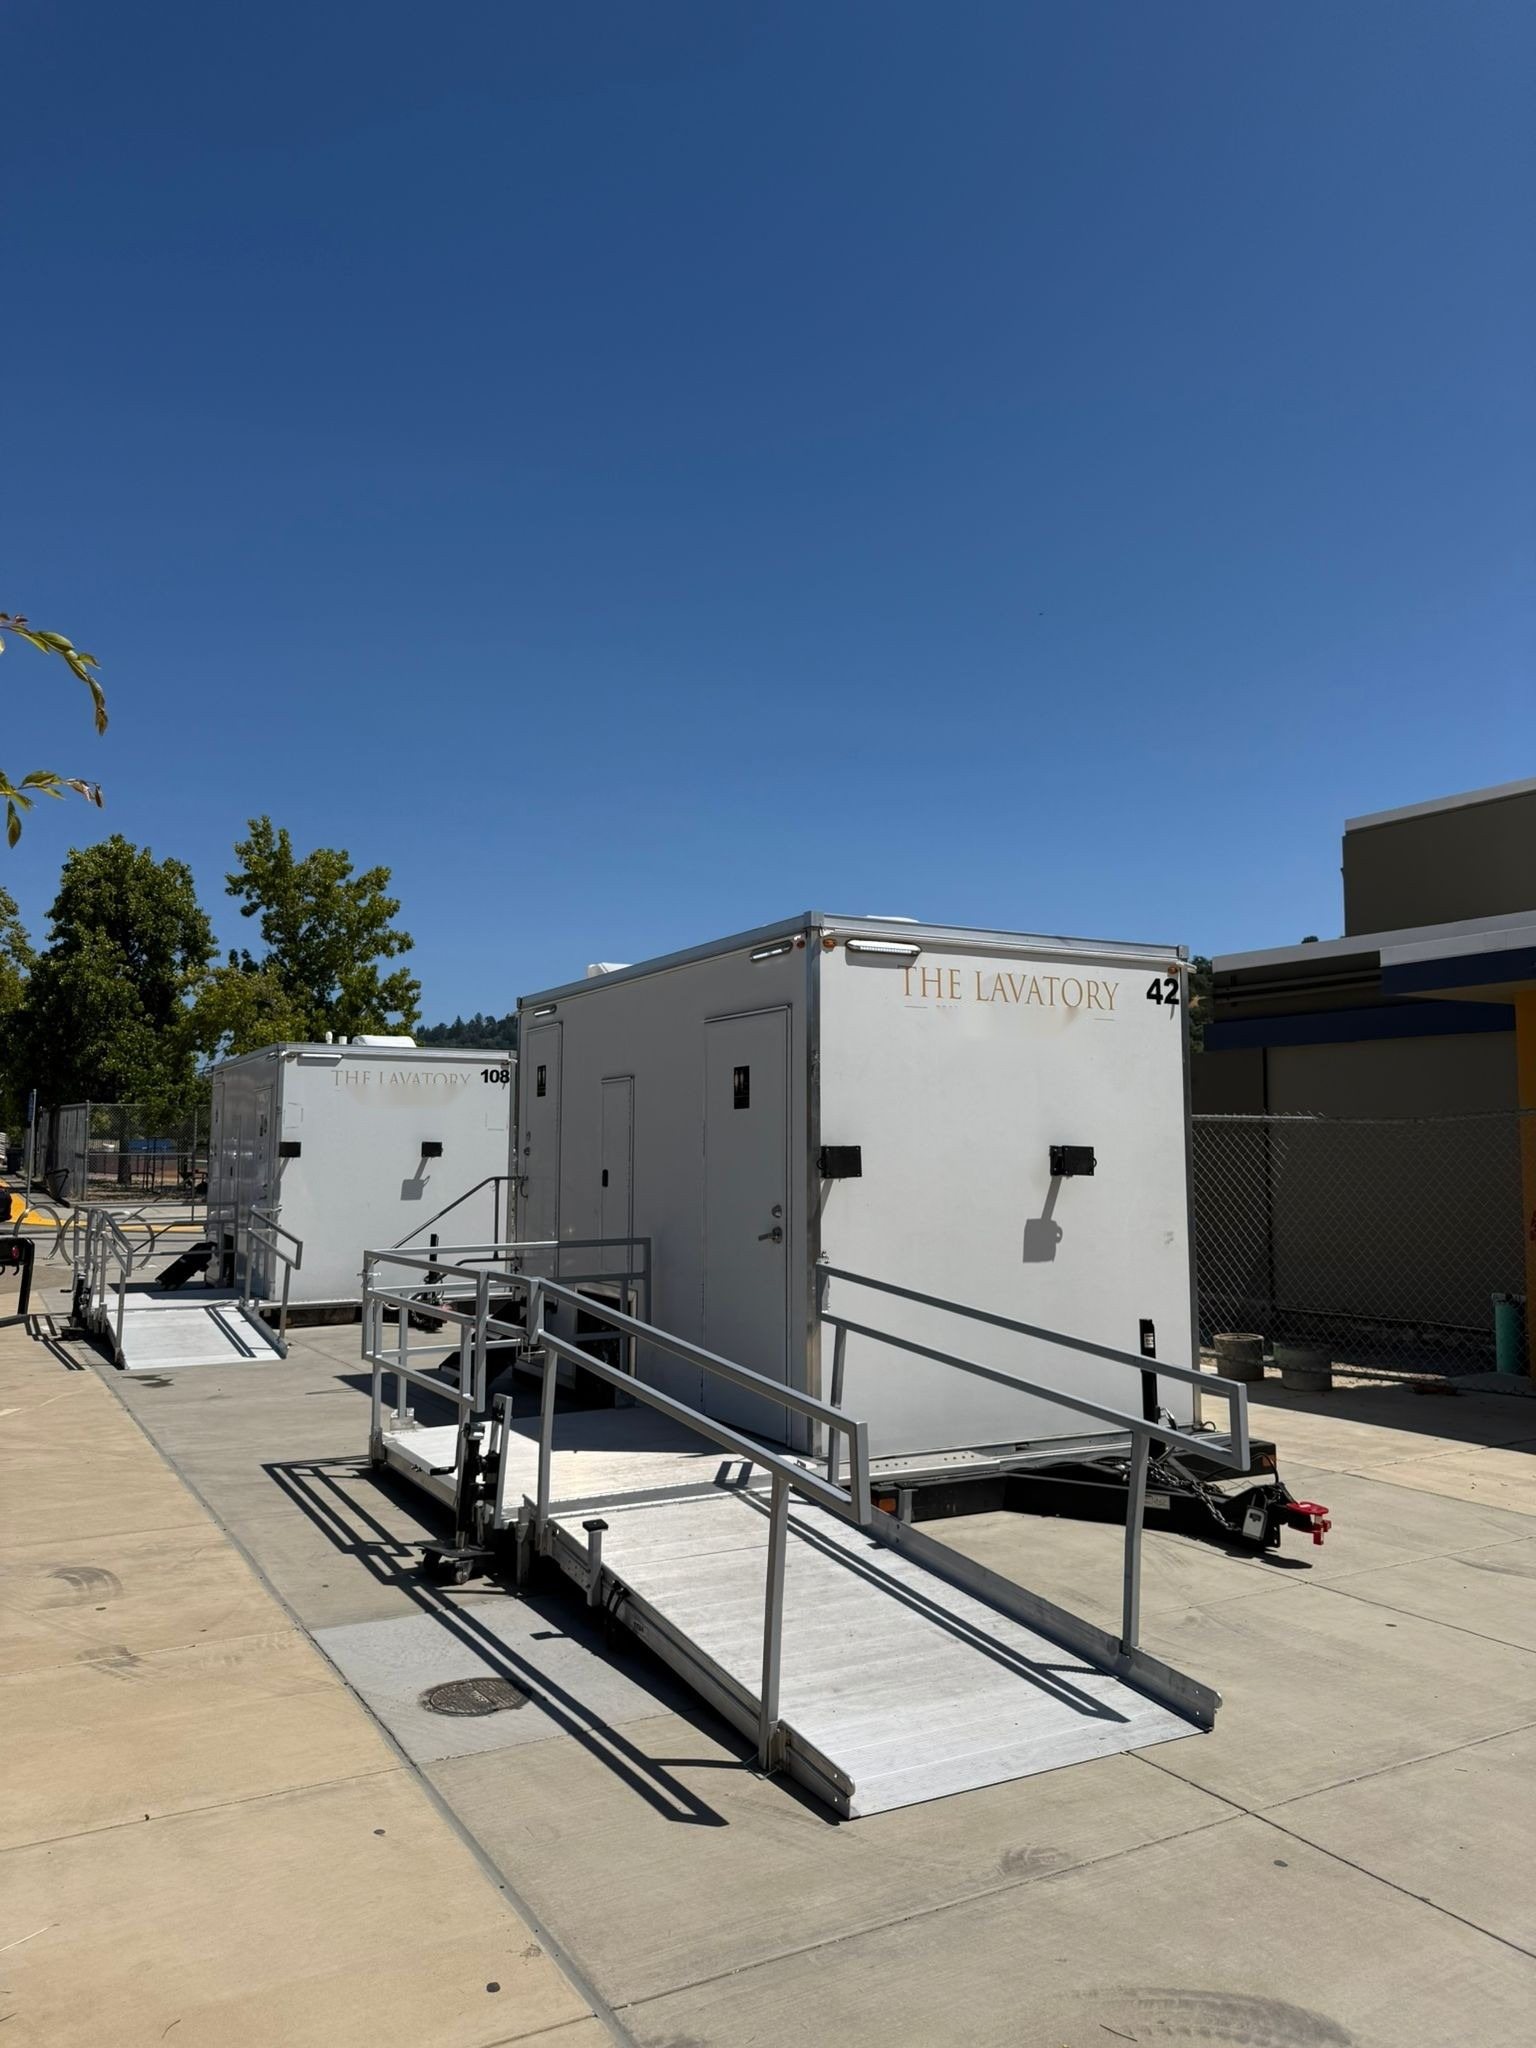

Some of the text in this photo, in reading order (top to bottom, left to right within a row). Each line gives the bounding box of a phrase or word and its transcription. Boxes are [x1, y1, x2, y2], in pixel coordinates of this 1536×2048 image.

[897, 965, 1120, 1011] THE LAVATORY
[1146, 978, 1180, 1006] 42
[480, 1068, 510, 1084] 108
